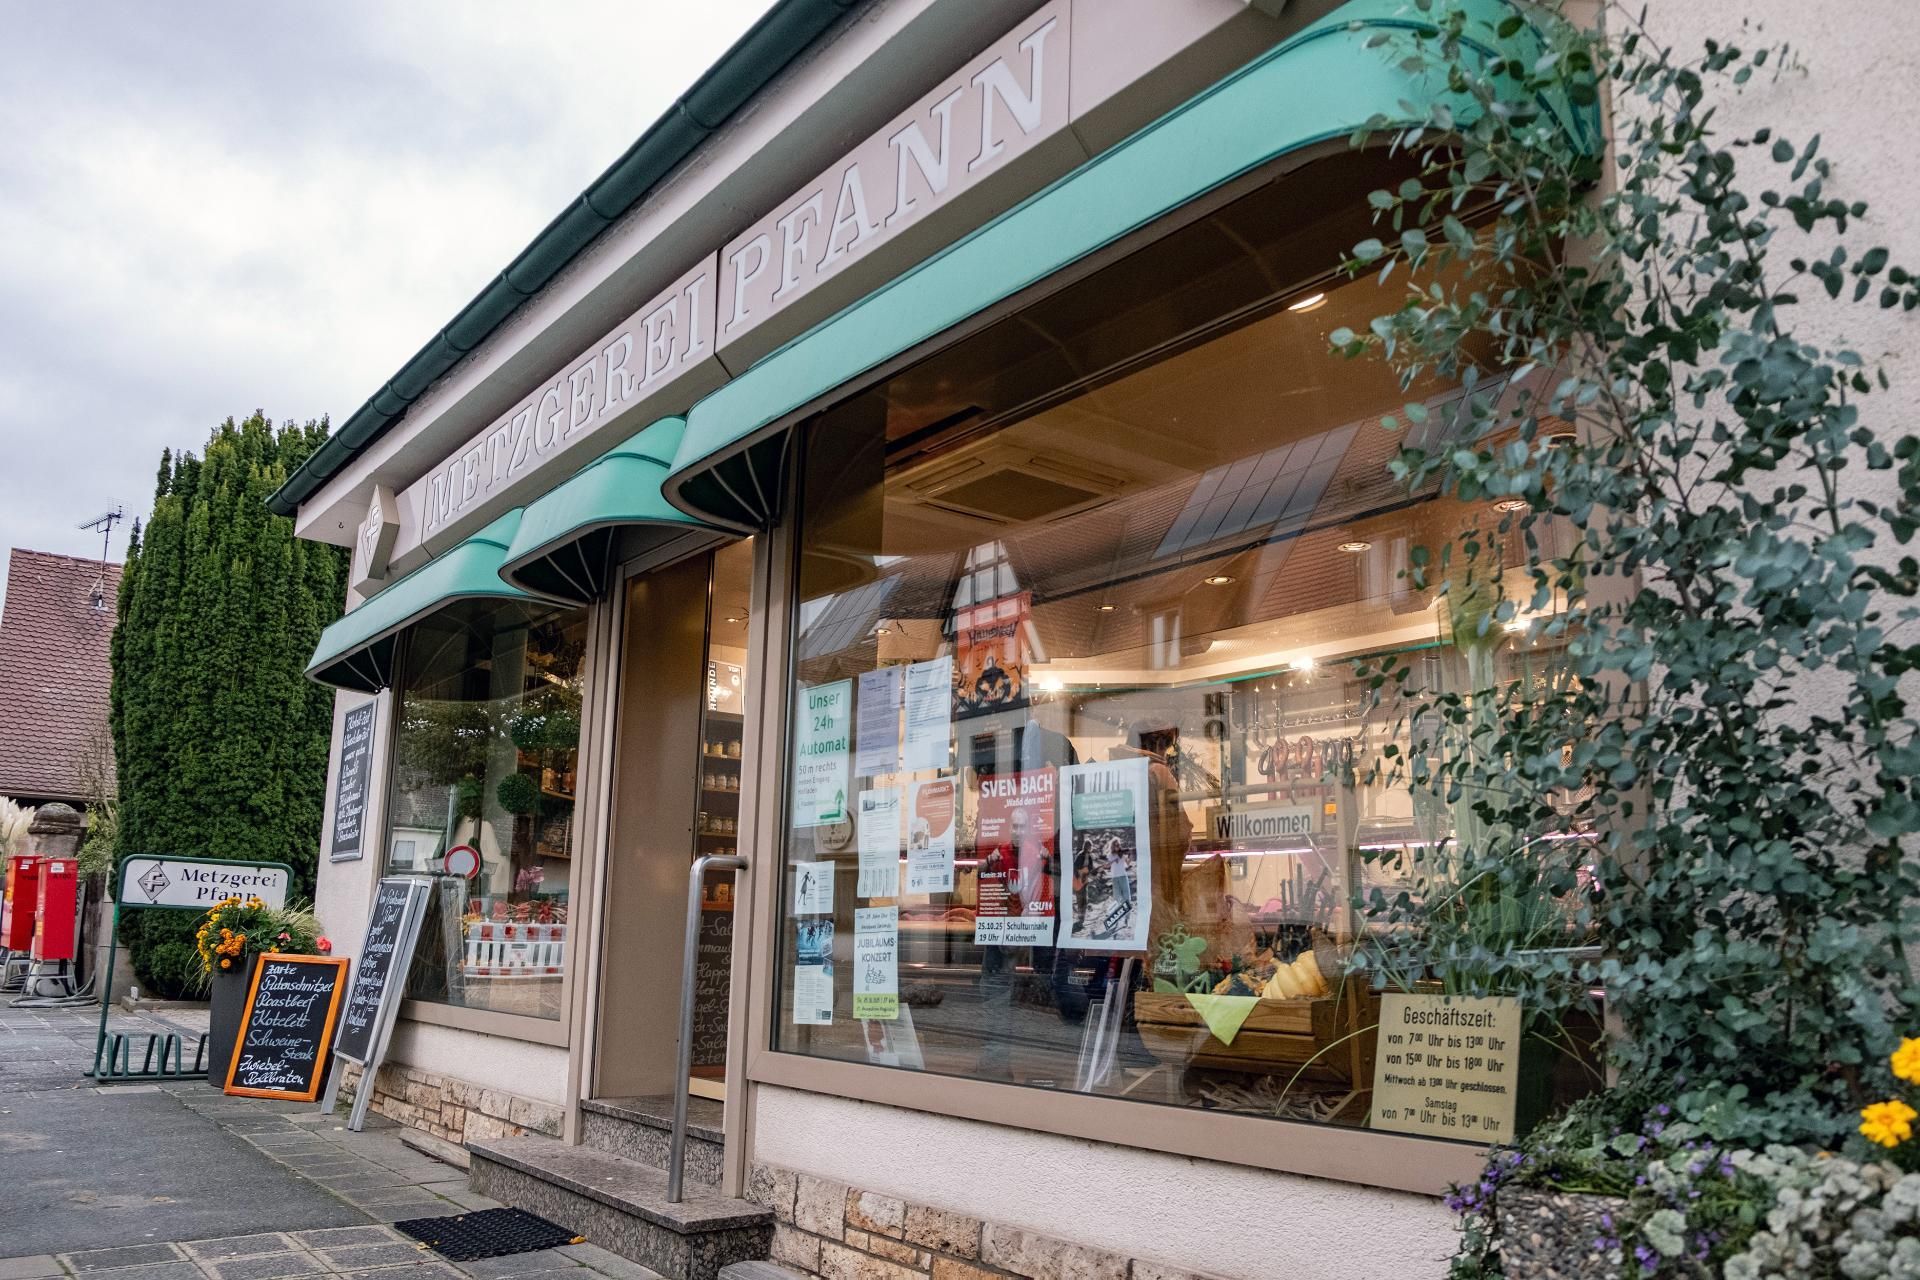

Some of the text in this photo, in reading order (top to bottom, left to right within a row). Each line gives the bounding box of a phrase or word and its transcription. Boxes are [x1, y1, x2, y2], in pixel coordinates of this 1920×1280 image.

[427, 15, 1057, 530] METZGEREI PFANN
[809, 691, 841, 710] Unser
[814, 717, 834, 732] 24h
[800, 736, 846, 757] Automat
[808, 766, 814, 774] m
[815, 761, 837, 773] rechts
[981, 773, 1054, 799] SVEN BACH
[1217, 813, 1311, 839] Willkommen
[181, 868, 277, 889] Metzgerei
[1029, 901, 1045, 911] CSU
[978, 921, 1048, 931] 25.10.25 Schulturnhalle
[979, 933, 1037, 943] 19 Uhr Kalchreuth
[862, 951, 891, 963] KONZERT
[265, 963, 297, 975] zarte
[260, 974, 334, 992] Putenschnitzel
[255, 991, 319, 1014] Roastbeef
[251, 1010, 311, 1028] Kotelett
[1404, 1006, 1496, 1028] Geschäftszeit:
[1387, 1034, 1403, 1045] von
[1428, 1034, 1444, 1047] Uhr
[1447, 1035, 1461, 1048] bis
[1488, 1037, 1505, 1051] Uhr
[280, 1045, 314, 1060] Steak
[1386, 1054, 1401, 1065] von
[1427, 1054, 1442, 1068] Uhr
[1446, 1055, 1460, 1069] bis
[1487, 1058, 1504, 1072] Uhr
[243, 1069, 304, 1085] Rollbraten
[1384, 1073, 1415, 1086] Mittwoch
[1418, 1077, 1426, 1087] ab
[1446, 1079, 1458, 1090] Uhr
[1460, 1081, 1507, 1095] geschlossen.
[1425, 1096, 1457, 1114] Samstag
[1382, 1108, 1397, 1120] von
[1420, 1109, 1436, 1124] Uhr
[1442, 1112, 1456, 1127] bis
[1483, 1115, 1500, 1131] Uhr
